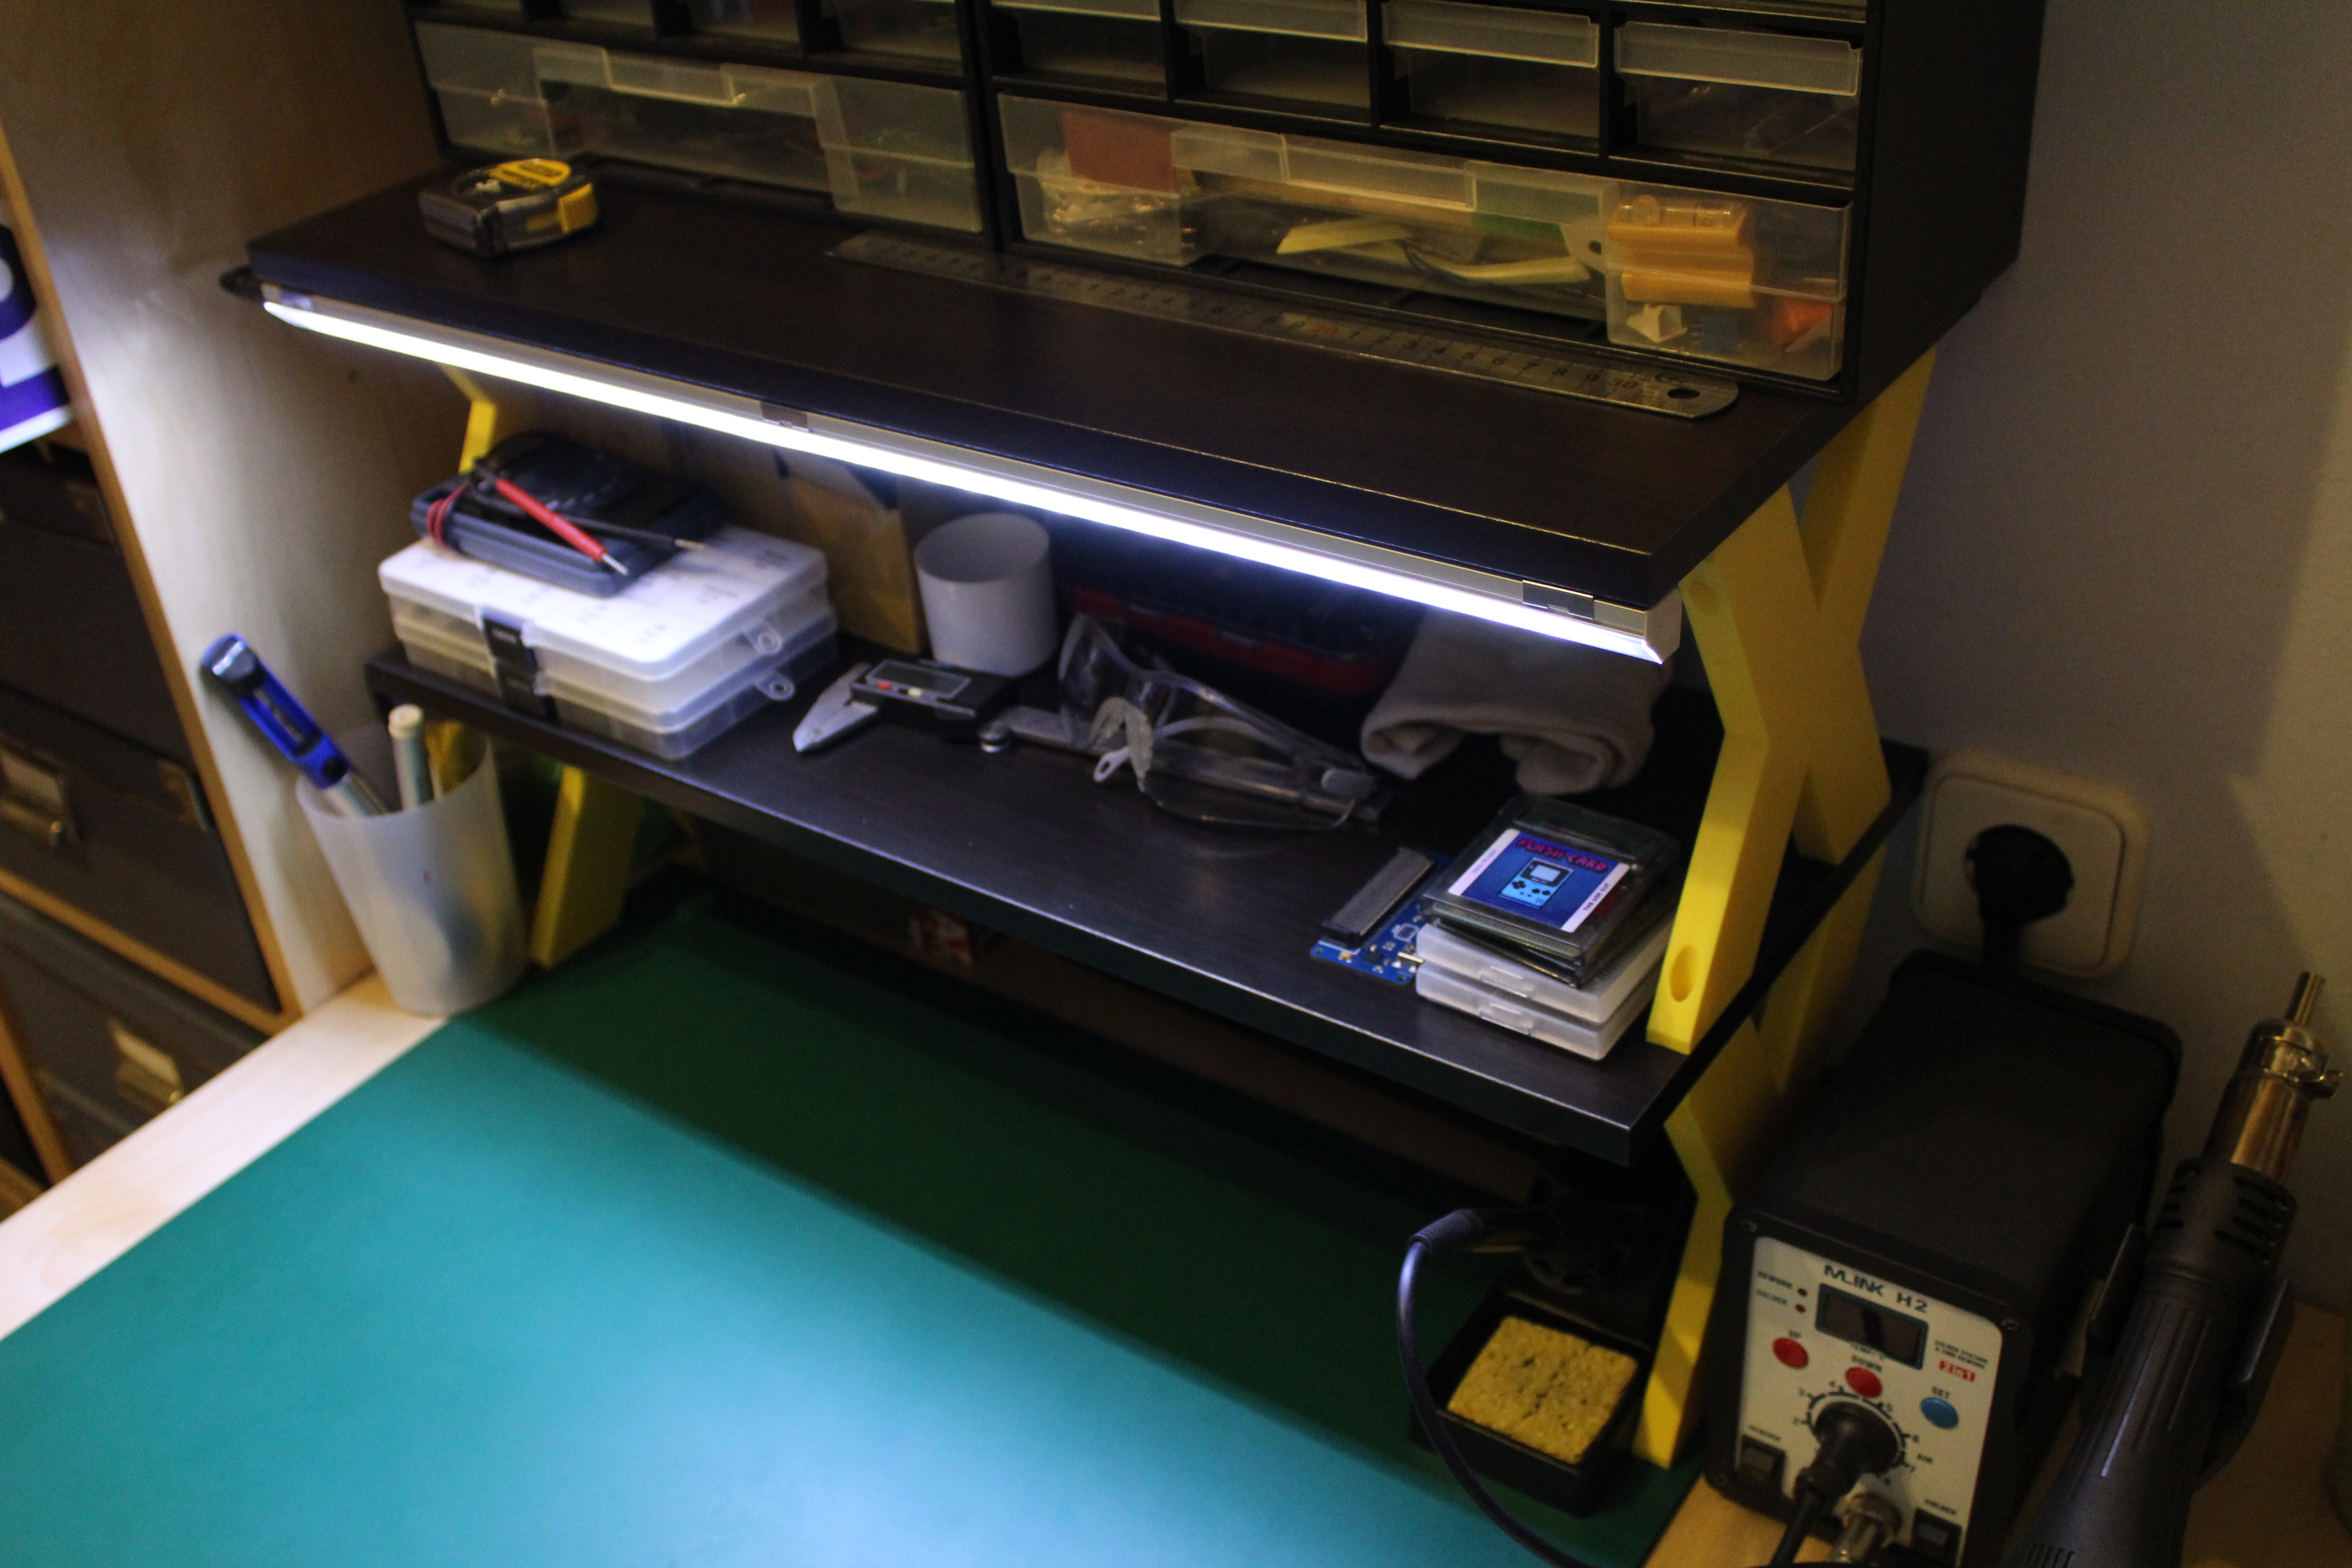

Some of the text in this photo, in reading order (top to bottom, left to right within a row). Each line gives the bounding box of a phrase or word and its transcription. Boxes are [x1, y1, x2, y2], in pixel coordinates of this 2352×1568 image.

[1491, 356, 1508, 366] 6
[1552, 367, 1569, 377] 8
[1583, 373, 1600, 382] 9
[1607, 377, 1639, 390] 30
[1516, 837, 1608, 873] FLASH CARD
[1896, 1292, 1929, 1314] H2
